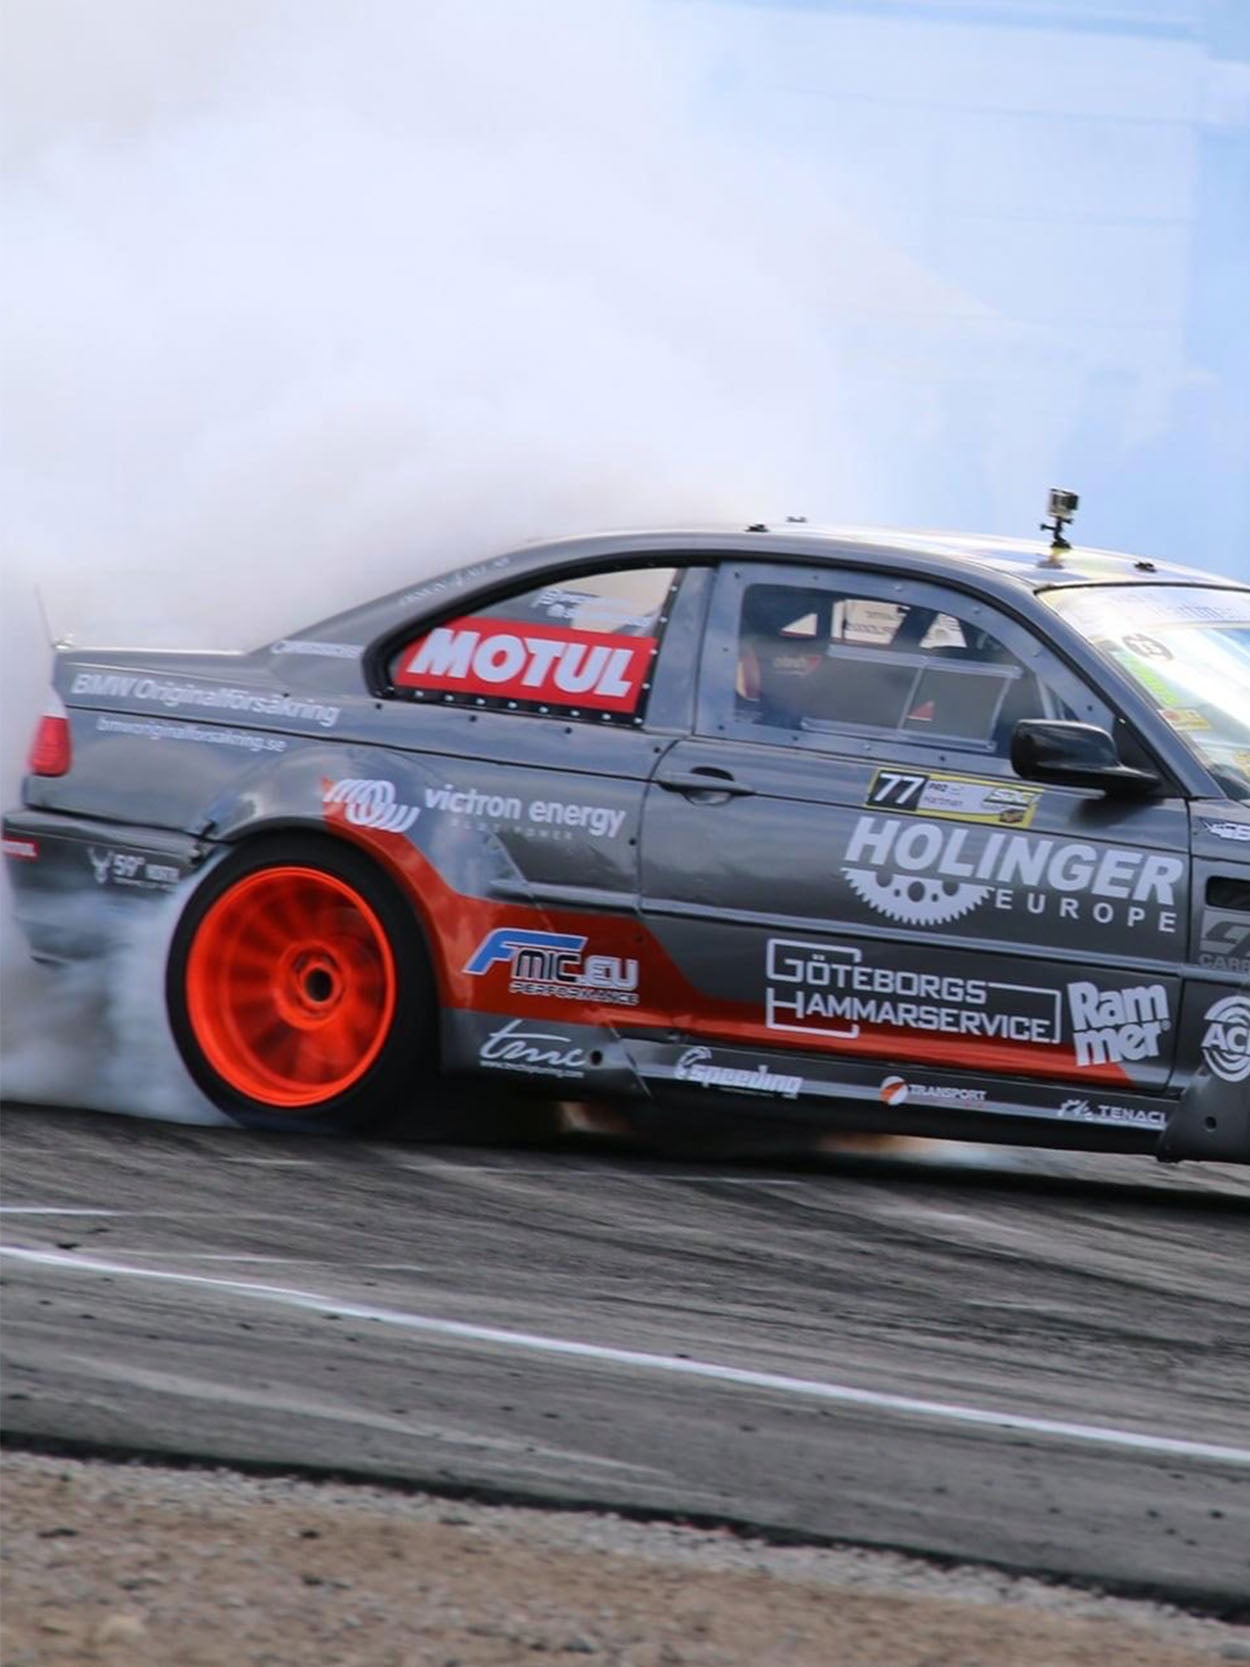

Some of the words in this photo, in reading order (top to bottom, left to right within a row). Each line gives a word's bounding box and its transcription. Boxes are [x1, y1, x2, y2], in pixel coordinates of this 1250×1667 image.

[70, 673, 137, 698] BMW
[406, 627, 635, 697] MOTUL
[424, 784, 521, 819] victron
[529, 797, 626, 837] energy
[875, 773, 925, 804] 77
[844, 816, 1184, 906] HOLINGER
[996, 888, 1178, 933] EUROPE
[509, 981, 640, 1006] PERFORMANCE
[767, 939, 988, 1004] GÖTEBORGS
[767, 987, 1051, 1043] HAMMARSERVICE
[1067, 981, 1169, 1032] Ram
[908, 1084, 988, 1101] TRANSPORT
[1097, 1105, 1167, 1124] TENACI
